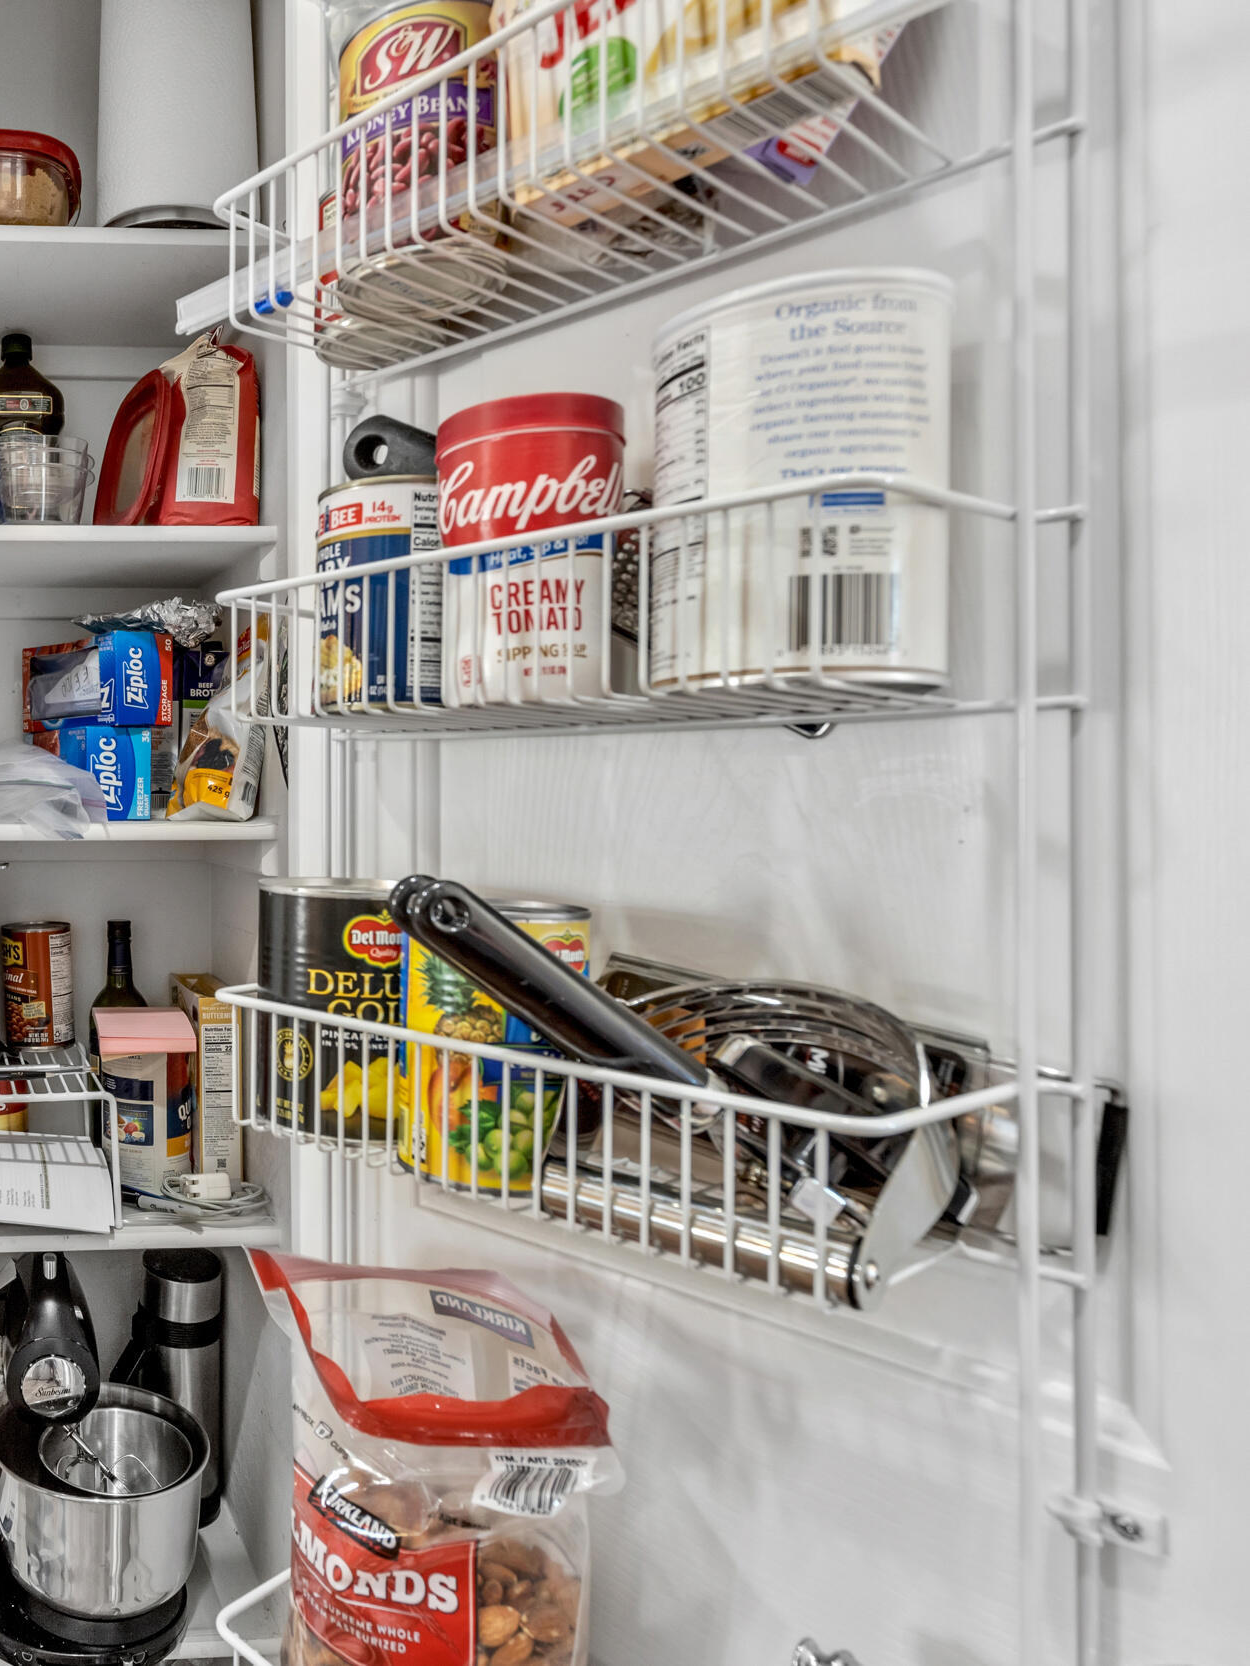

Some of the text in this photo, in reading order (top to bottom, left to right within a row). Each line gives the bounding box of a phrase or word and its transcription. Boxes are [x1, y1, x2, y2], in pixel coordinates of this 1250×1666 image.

[364, 25, 455, 90] S&W
[775, 297, 866, 321] Organic
[790, 318, 907, 342] the Source
[678, 372, 706, 393] 100
[331, 507, 357, 528] BEE
[491, 578, 585, 610] CREAMY
[492, 606, 582, 636] TOMATO
[165, 638, 172, 652] 50
[497, 643, 588, 663] SIPPNG SUP
[126, 647, 148, 705] Ziploc
[190, 688, 216, 698] BROT
[95, 737, 122, 804] Ziploc
[207, 784, 224, 795] 425
[351, 929, 402, 945] Del Mon
[2, 944, 20, 961] SH'S
[370, 947, 400, 959] Quality
[6, 970, 24, 983] inal
[307, 968, 402, 999] DELU
[327, 999, 403, 1026] GOL
[335, 1041, 359, 1050] 10%
[317, 1482, 398, 1549] KIRKLAND
[323, 1599, 421, 1643] SUPREME WHOLE
[330, 1615, 407, 1654] PASTEURIZED
